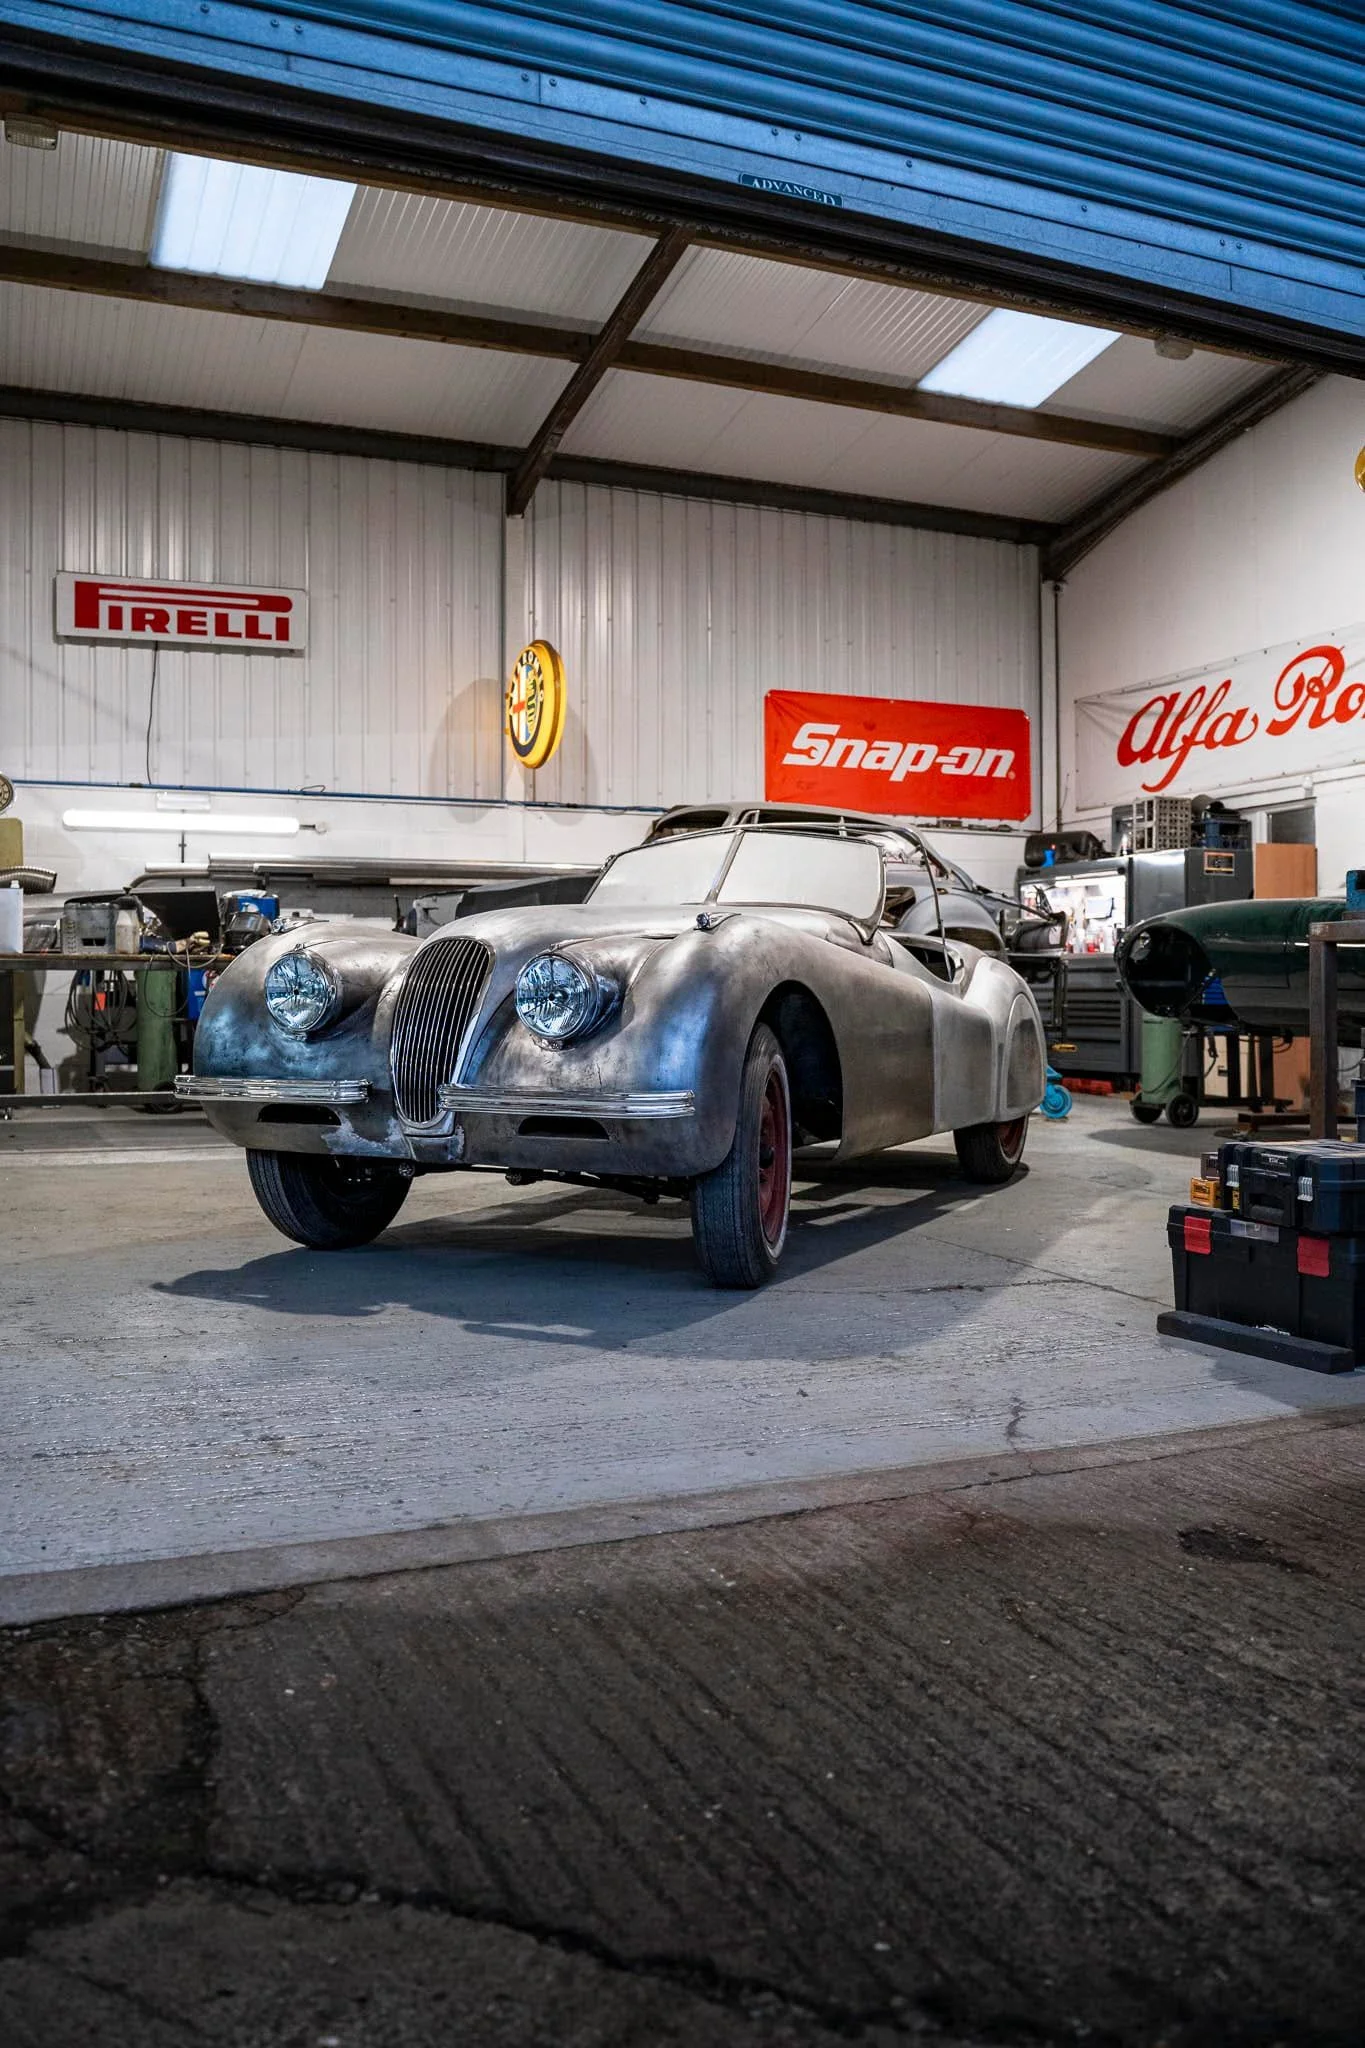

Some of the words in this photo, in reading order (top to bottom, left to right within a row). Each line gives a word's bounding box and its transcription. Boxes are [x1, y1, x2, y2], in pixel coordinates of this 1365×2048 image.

[752, 178, 835, 206] ADVANCED
[75, 581, 292, 642] PIRELLI
[1117, 679, 1258, 793] Alfa
[1266, 645, 1365, 736] Ro
[782, 722, 1015, 782] Snap-on
